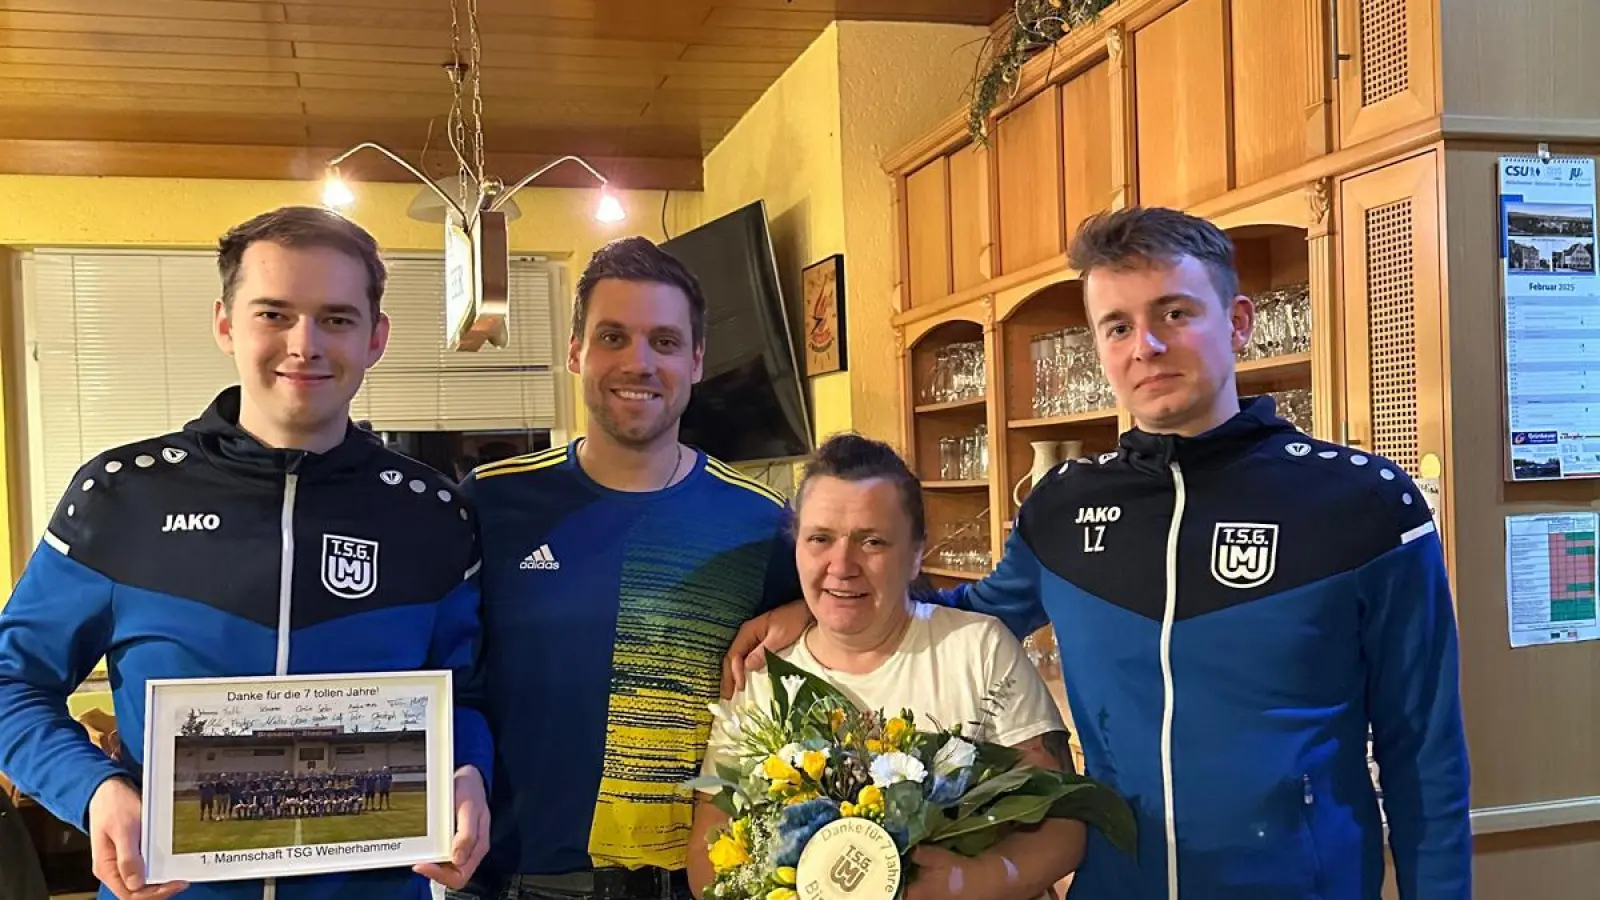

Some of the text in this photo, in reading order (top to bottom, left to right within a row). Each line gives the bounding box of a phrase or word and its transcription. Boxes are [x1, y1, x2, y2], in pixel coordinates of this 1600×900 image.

[1505, 165, 1529, 177] CSU
[1529, 282, 1557, 292] Februar
[162, 514, 220, 532] JAKO
[1075, 506, 1121, 524] JAKO
[1084, 525, 1106, 553] LZ
[519, 559, 560, 570] adidas
[227, 686, 380, 702] Danke für die 7 tollen Jahre!
[201, 841, 402, 864] 1. Mannschaft TSG Weiherhammer
[820, 820, 899, 893] Danke für 7 Jahre
